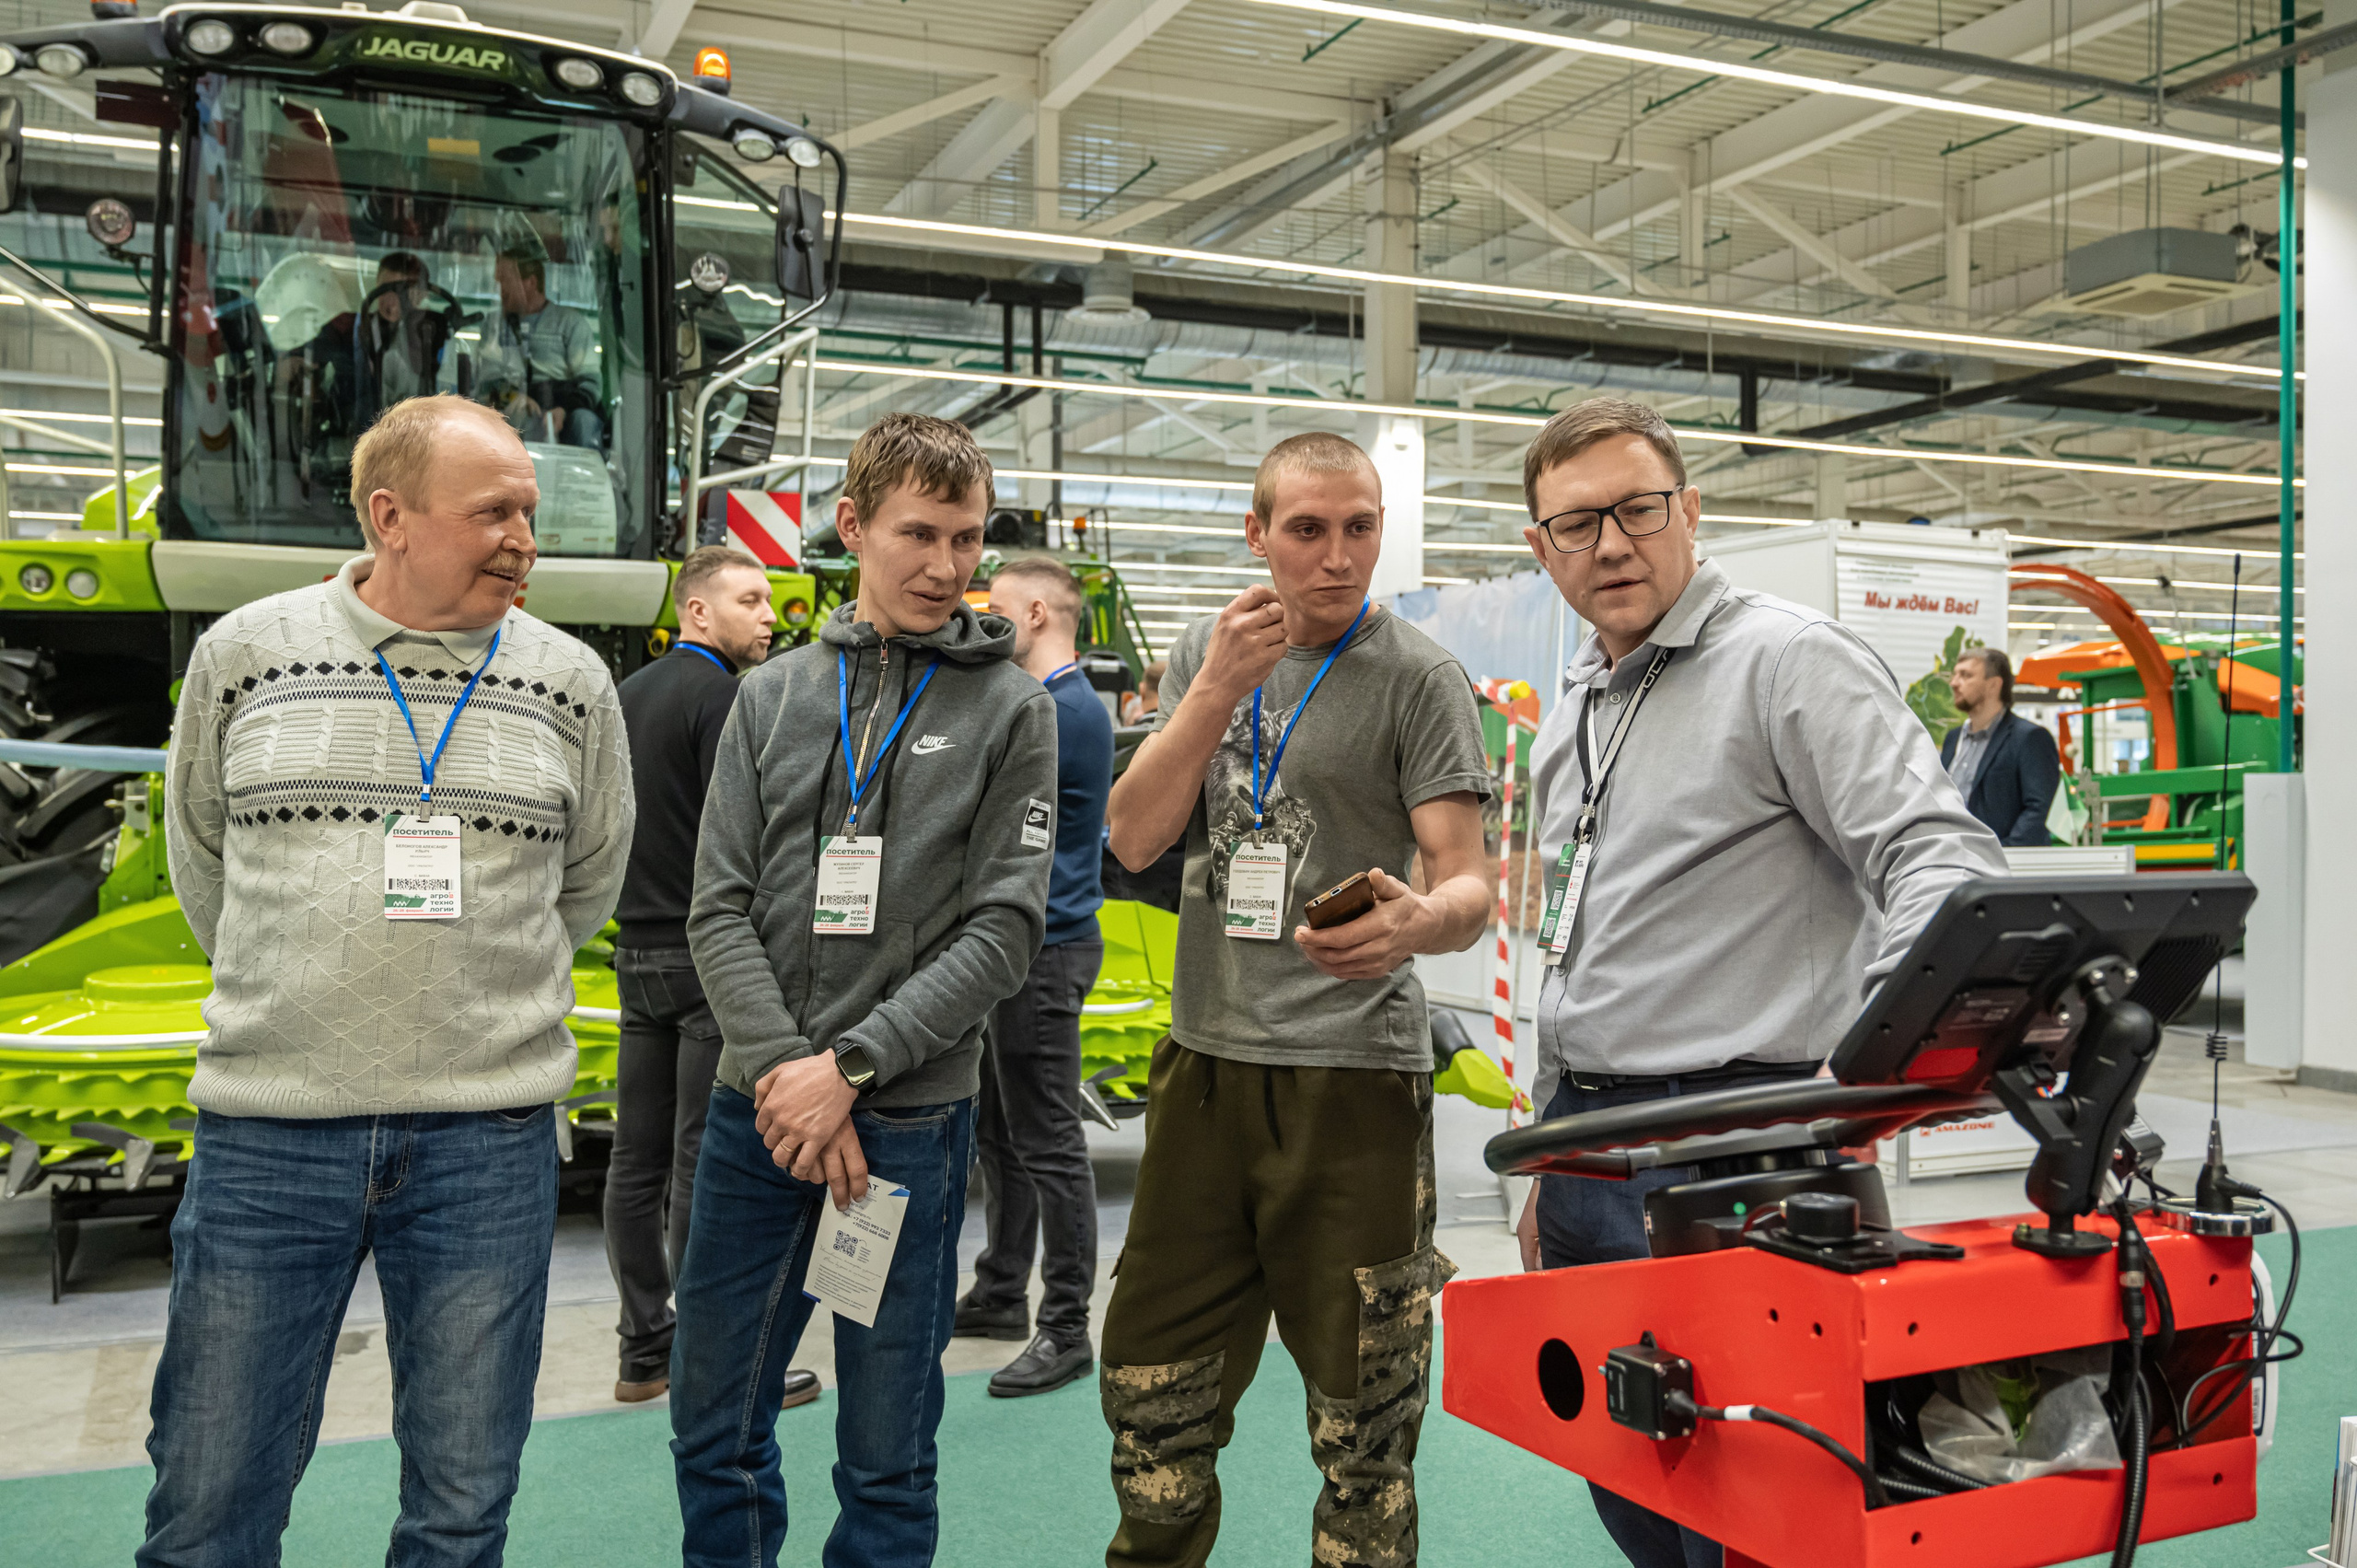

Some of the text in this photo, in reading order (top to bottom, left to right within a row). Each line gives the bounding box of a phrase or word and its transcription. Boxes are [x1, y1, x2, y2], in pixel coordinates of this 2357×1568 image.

[363, 36, 505, 71] JAGUAR
[1865, 591, 1979, 615] Мы ждём Вас!
[918, 734, 948, 748] NIKE
[392, 828, 454, 836] посетитель
[1935, 1122, 1993, 1132] AMAZONE
